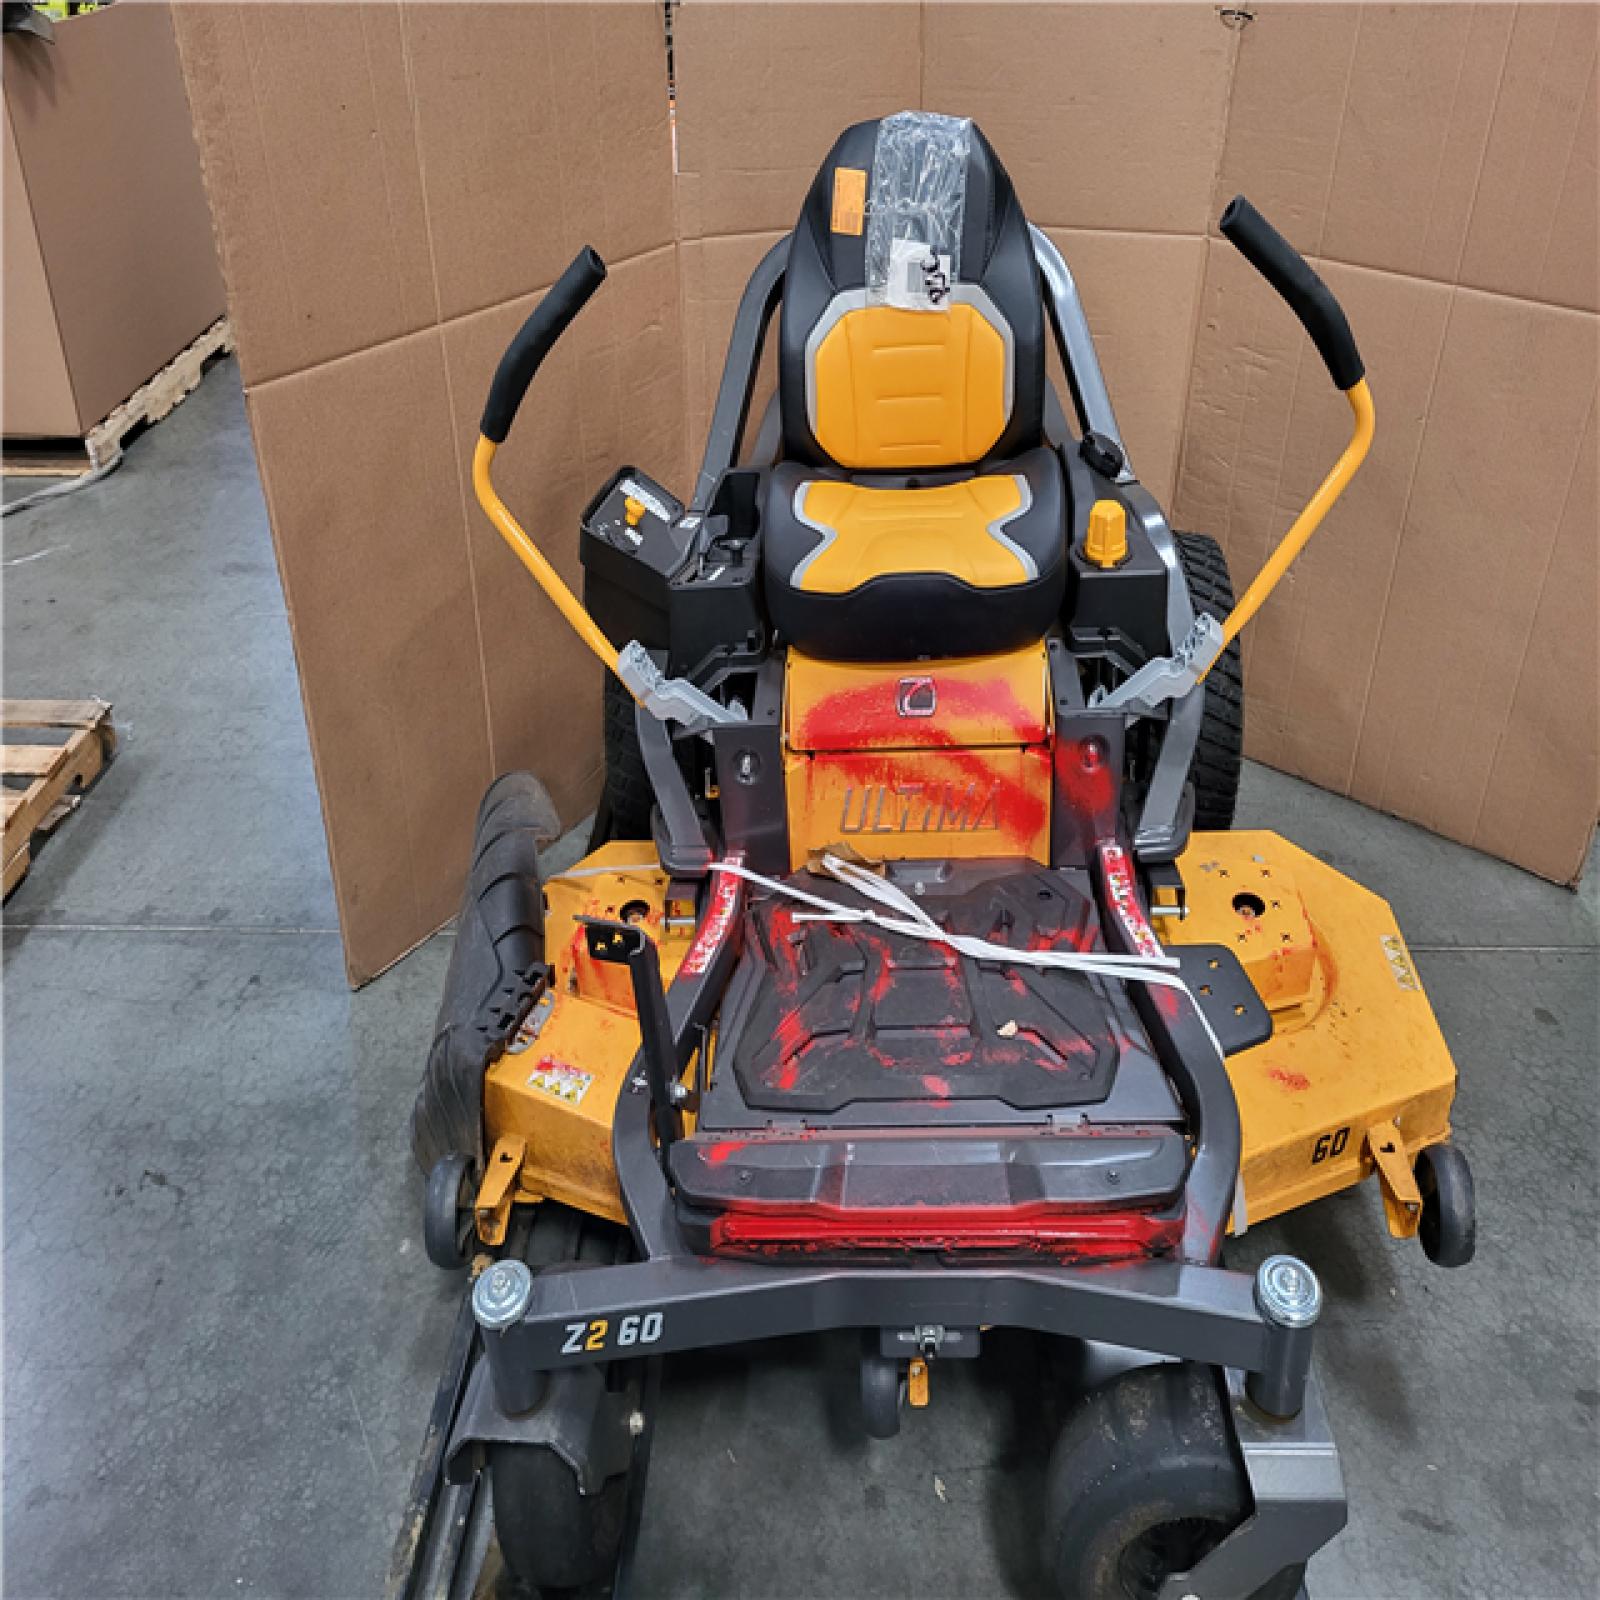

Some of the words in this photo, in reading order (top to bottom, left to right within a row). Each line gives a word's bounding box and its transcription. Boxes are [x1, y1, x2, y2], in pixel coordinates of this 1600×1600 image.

[840, 780, 1001, 833] ULTIMA
[1311, 1127, 1350, 1165] 60
[561, 1319, 608, 1353] Z2
[617, 1312, 663, 1345] 60
